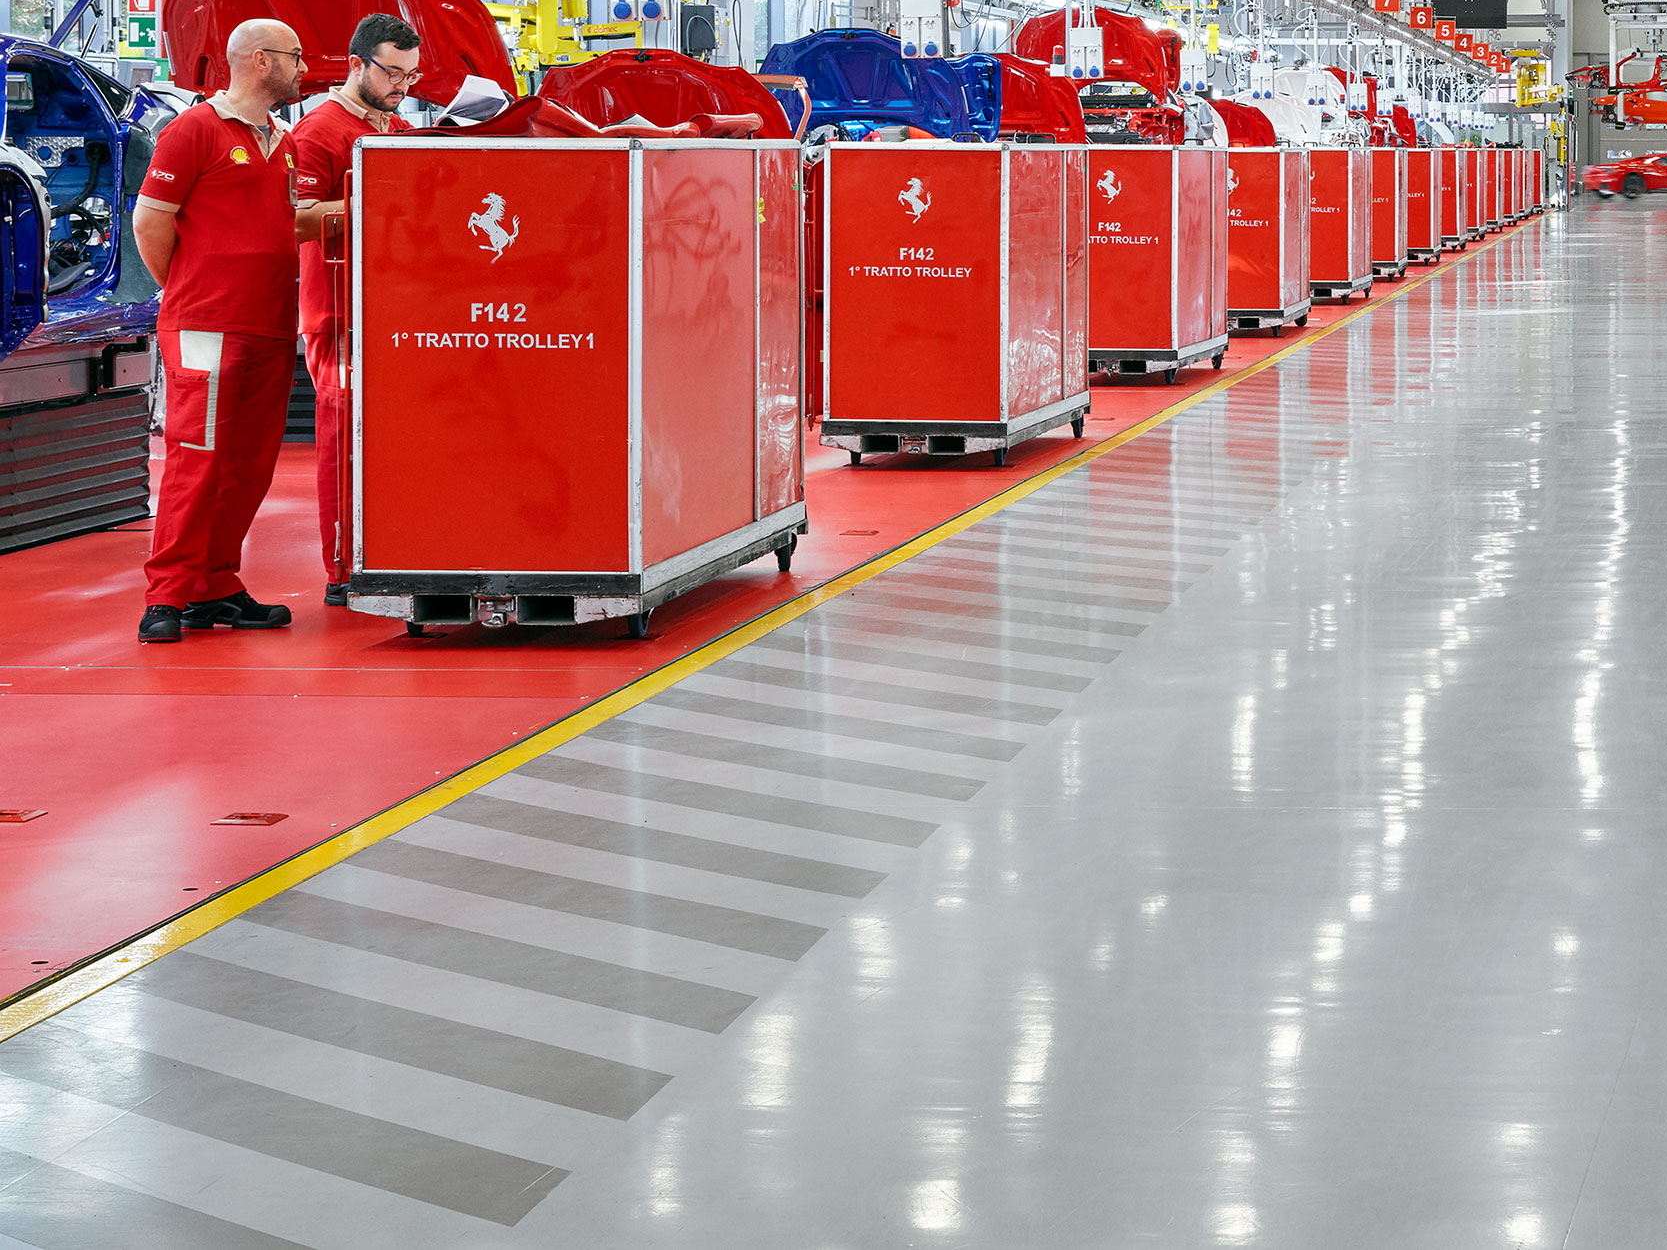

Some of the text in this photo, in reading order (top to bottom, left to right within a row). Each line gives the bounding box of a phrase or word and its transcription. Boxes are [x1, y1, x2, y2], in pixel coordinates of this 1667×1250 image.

[1416, 11, 1427, 25] 6
[1440, 24, 1450, 37] 5
[1459, 37, 1468, 49] 4
[1476, 46, 1485, 57] 3
[1490, 54, 1498, 64] 2
[1500, 61, 1506, 71] 1
[1227, 208, 1242, 217] 142
[1097, 221, 1122, 233] F142
[1229, 219, 1264, 227] TROLLEY
[1109, 235, 1153, 245] TROLLEY
[1154, 236, 1159, 245] 1
[899, 247, 935, 261] F142
[848, 266, 973, 278] 1° TRATTO TROLLEY
[391, 332, 409, 348] 1°
[413, 332, 489, 349] TRATTO
